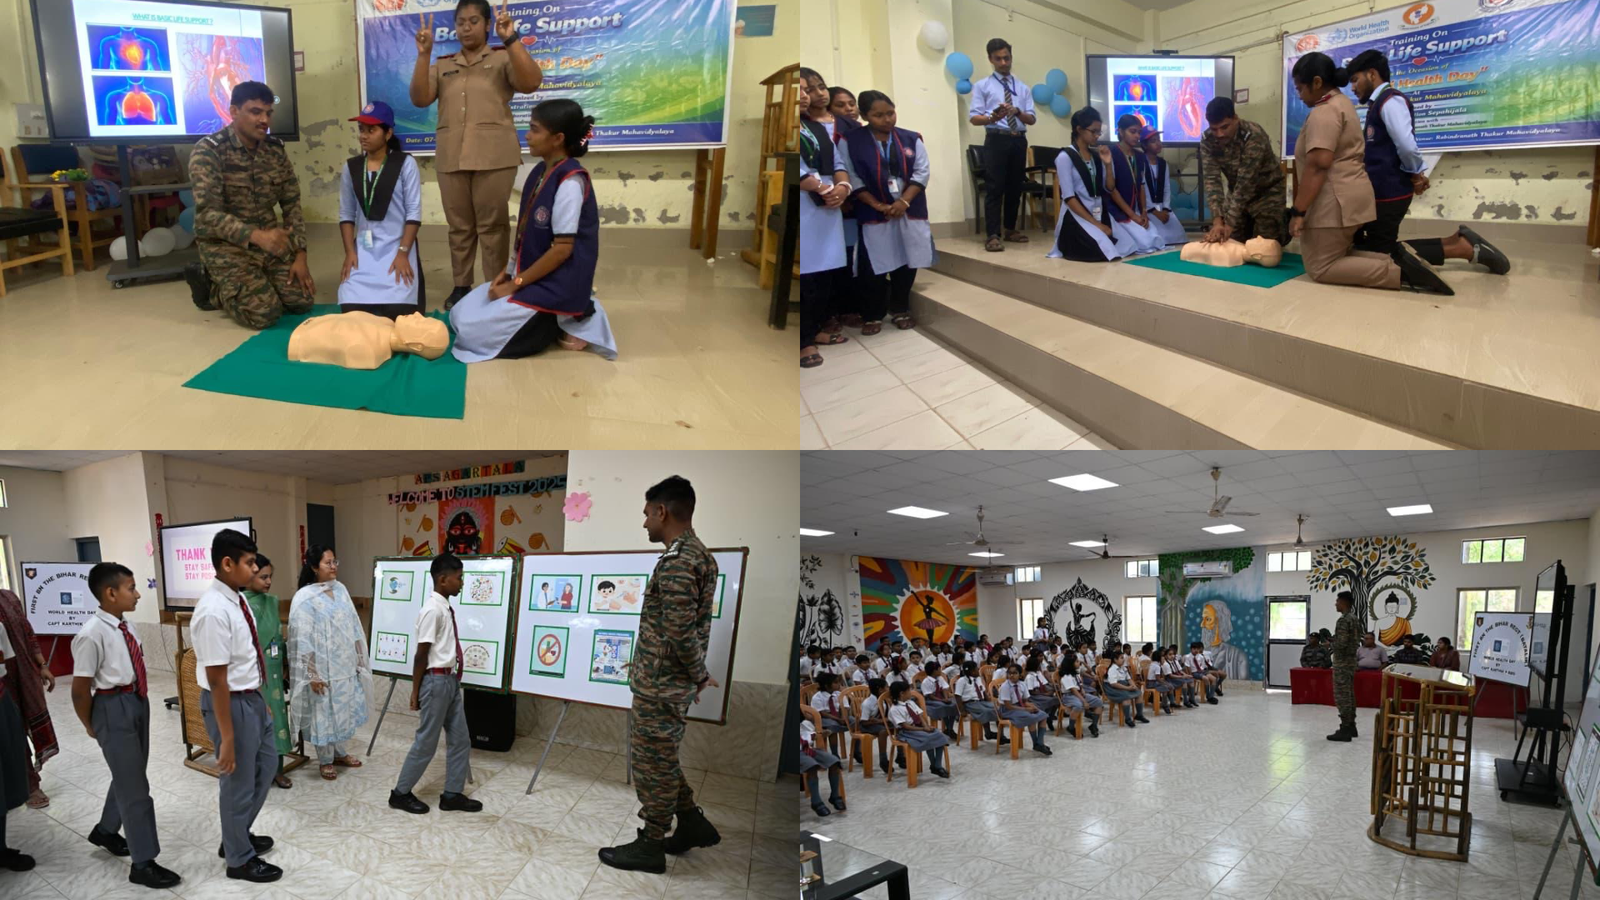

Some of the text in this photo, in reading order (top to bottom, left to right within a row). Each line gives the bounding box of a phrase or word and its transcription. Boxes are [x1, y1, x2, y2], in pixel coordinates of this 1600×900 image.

[543, 4, 560, 13] On
[536, 12, 622, 34] Support
[1349, 24, 1367, 33] World
[1368, 20, 1390, 29] Health
[1349, 26, 1390, 39] Organization
[1390, 30, 1448, 46] Training On
[1388, 28, 1508, 62] Life Support
[1398, 73, 1442, 88] Health
[1424, 89, 1487, 100] Mahavidyalaya
[1428, 107, 1466, 116] Sepahijala
[622, 128, 674, 136] Mahavidyalaya
[443, 460, 524, 481] AGARTALA
[440, 486, 454, 500] TO
[528, 475, 566, 494] 2025
[176, 548, 205, 561] THANK
[36, 585, 44, 594] BN
[43, 576, 55, 585] THE
[1510, 623, 1520, 634] REGT
